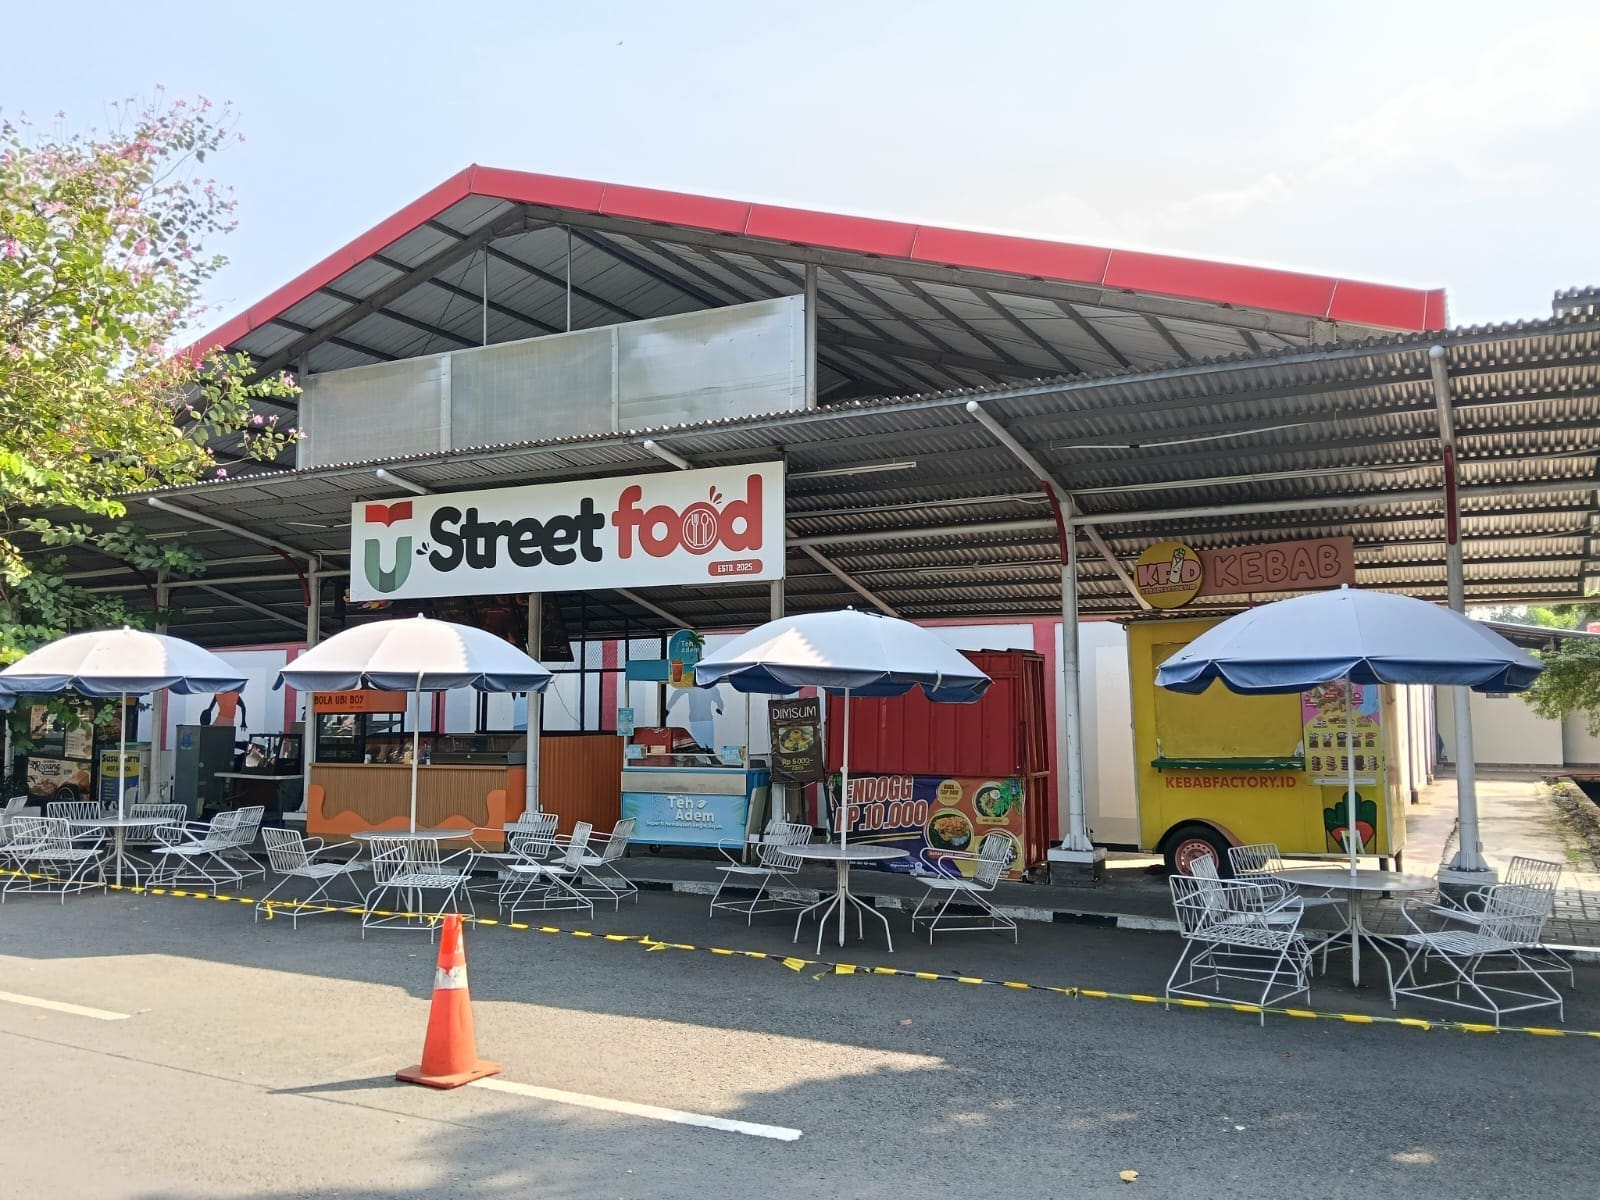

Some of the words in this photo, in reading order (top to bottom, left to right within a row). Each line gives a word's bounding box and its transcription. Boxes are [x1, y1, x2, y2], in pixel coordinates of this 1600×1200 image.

[428, 497, 605, 573] Street
[611, 473, 763, 560] food
[736, 562, 753, 571] 2025
[1213, 544, 1342, 588] KEBAB
[314, 695, 333, 705] BOLA
[335, 695, 348, 705] UBI
[349, 695, 365, 705] BOY
[772, 705, 817, 720] DIMSUM
[102, 753, 119, 762] Susu
[1165, 776, 1297, 789] KEBABFACTORY.ID
[667, 795, 694, 809] Teh
[675, 809, 715, 822] Adem
